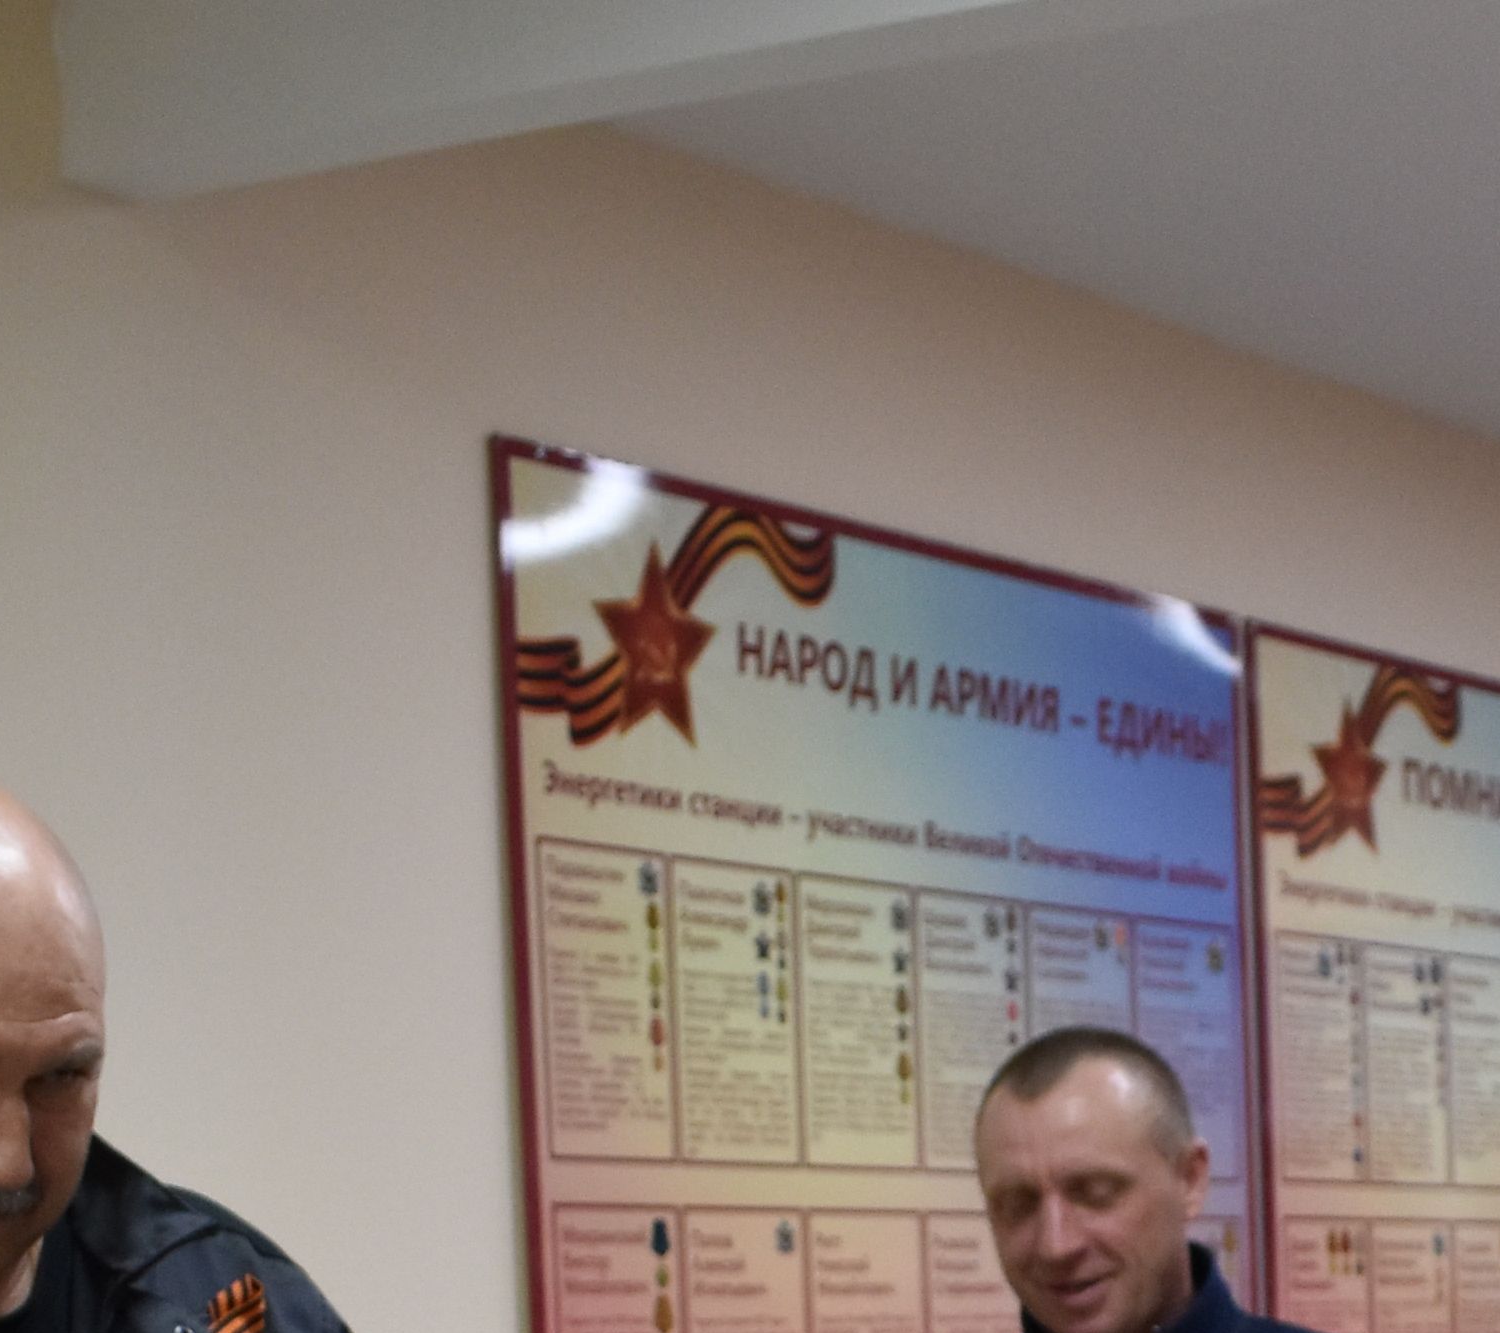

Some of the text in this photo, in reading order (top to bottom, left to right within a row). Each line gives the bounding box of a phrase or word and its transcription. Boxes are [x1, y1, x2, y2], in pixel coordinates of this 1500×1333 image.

[738, 621, 879, 712] НАРОД
[890, 652, 917, 709] И
[929, 664, 1060, 736] АРМИЯ
[544, 759, 682, 809] Энергетики
